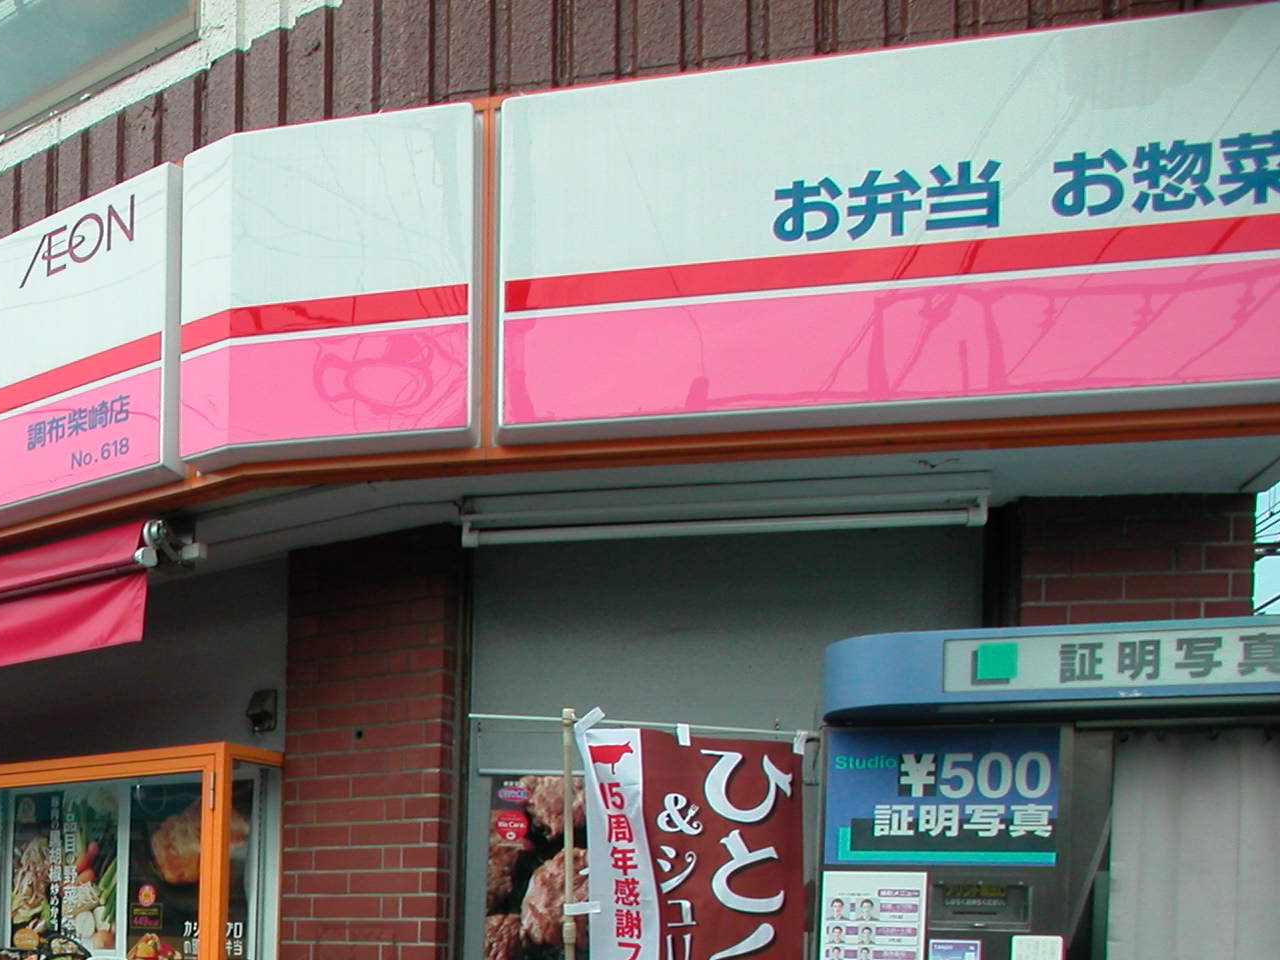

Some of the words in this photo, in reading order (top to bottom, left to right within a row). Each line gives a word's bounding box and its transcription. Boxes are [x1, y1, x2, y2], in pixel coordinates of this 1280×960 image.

[773, 160, 1002, 242] お弁当
[1049, 129, 1280, 218] お惣菜
[26, 394, 131, 451] 調布柴崎店
[71, 437, 130, 470] No.618
[1059, 632, 1280, 684] 証明写真
[835, 755, 897, 770] Studio
[899, 751, 1052, 799] ¥500
[872, 803, 1053, 838] 証明写真
